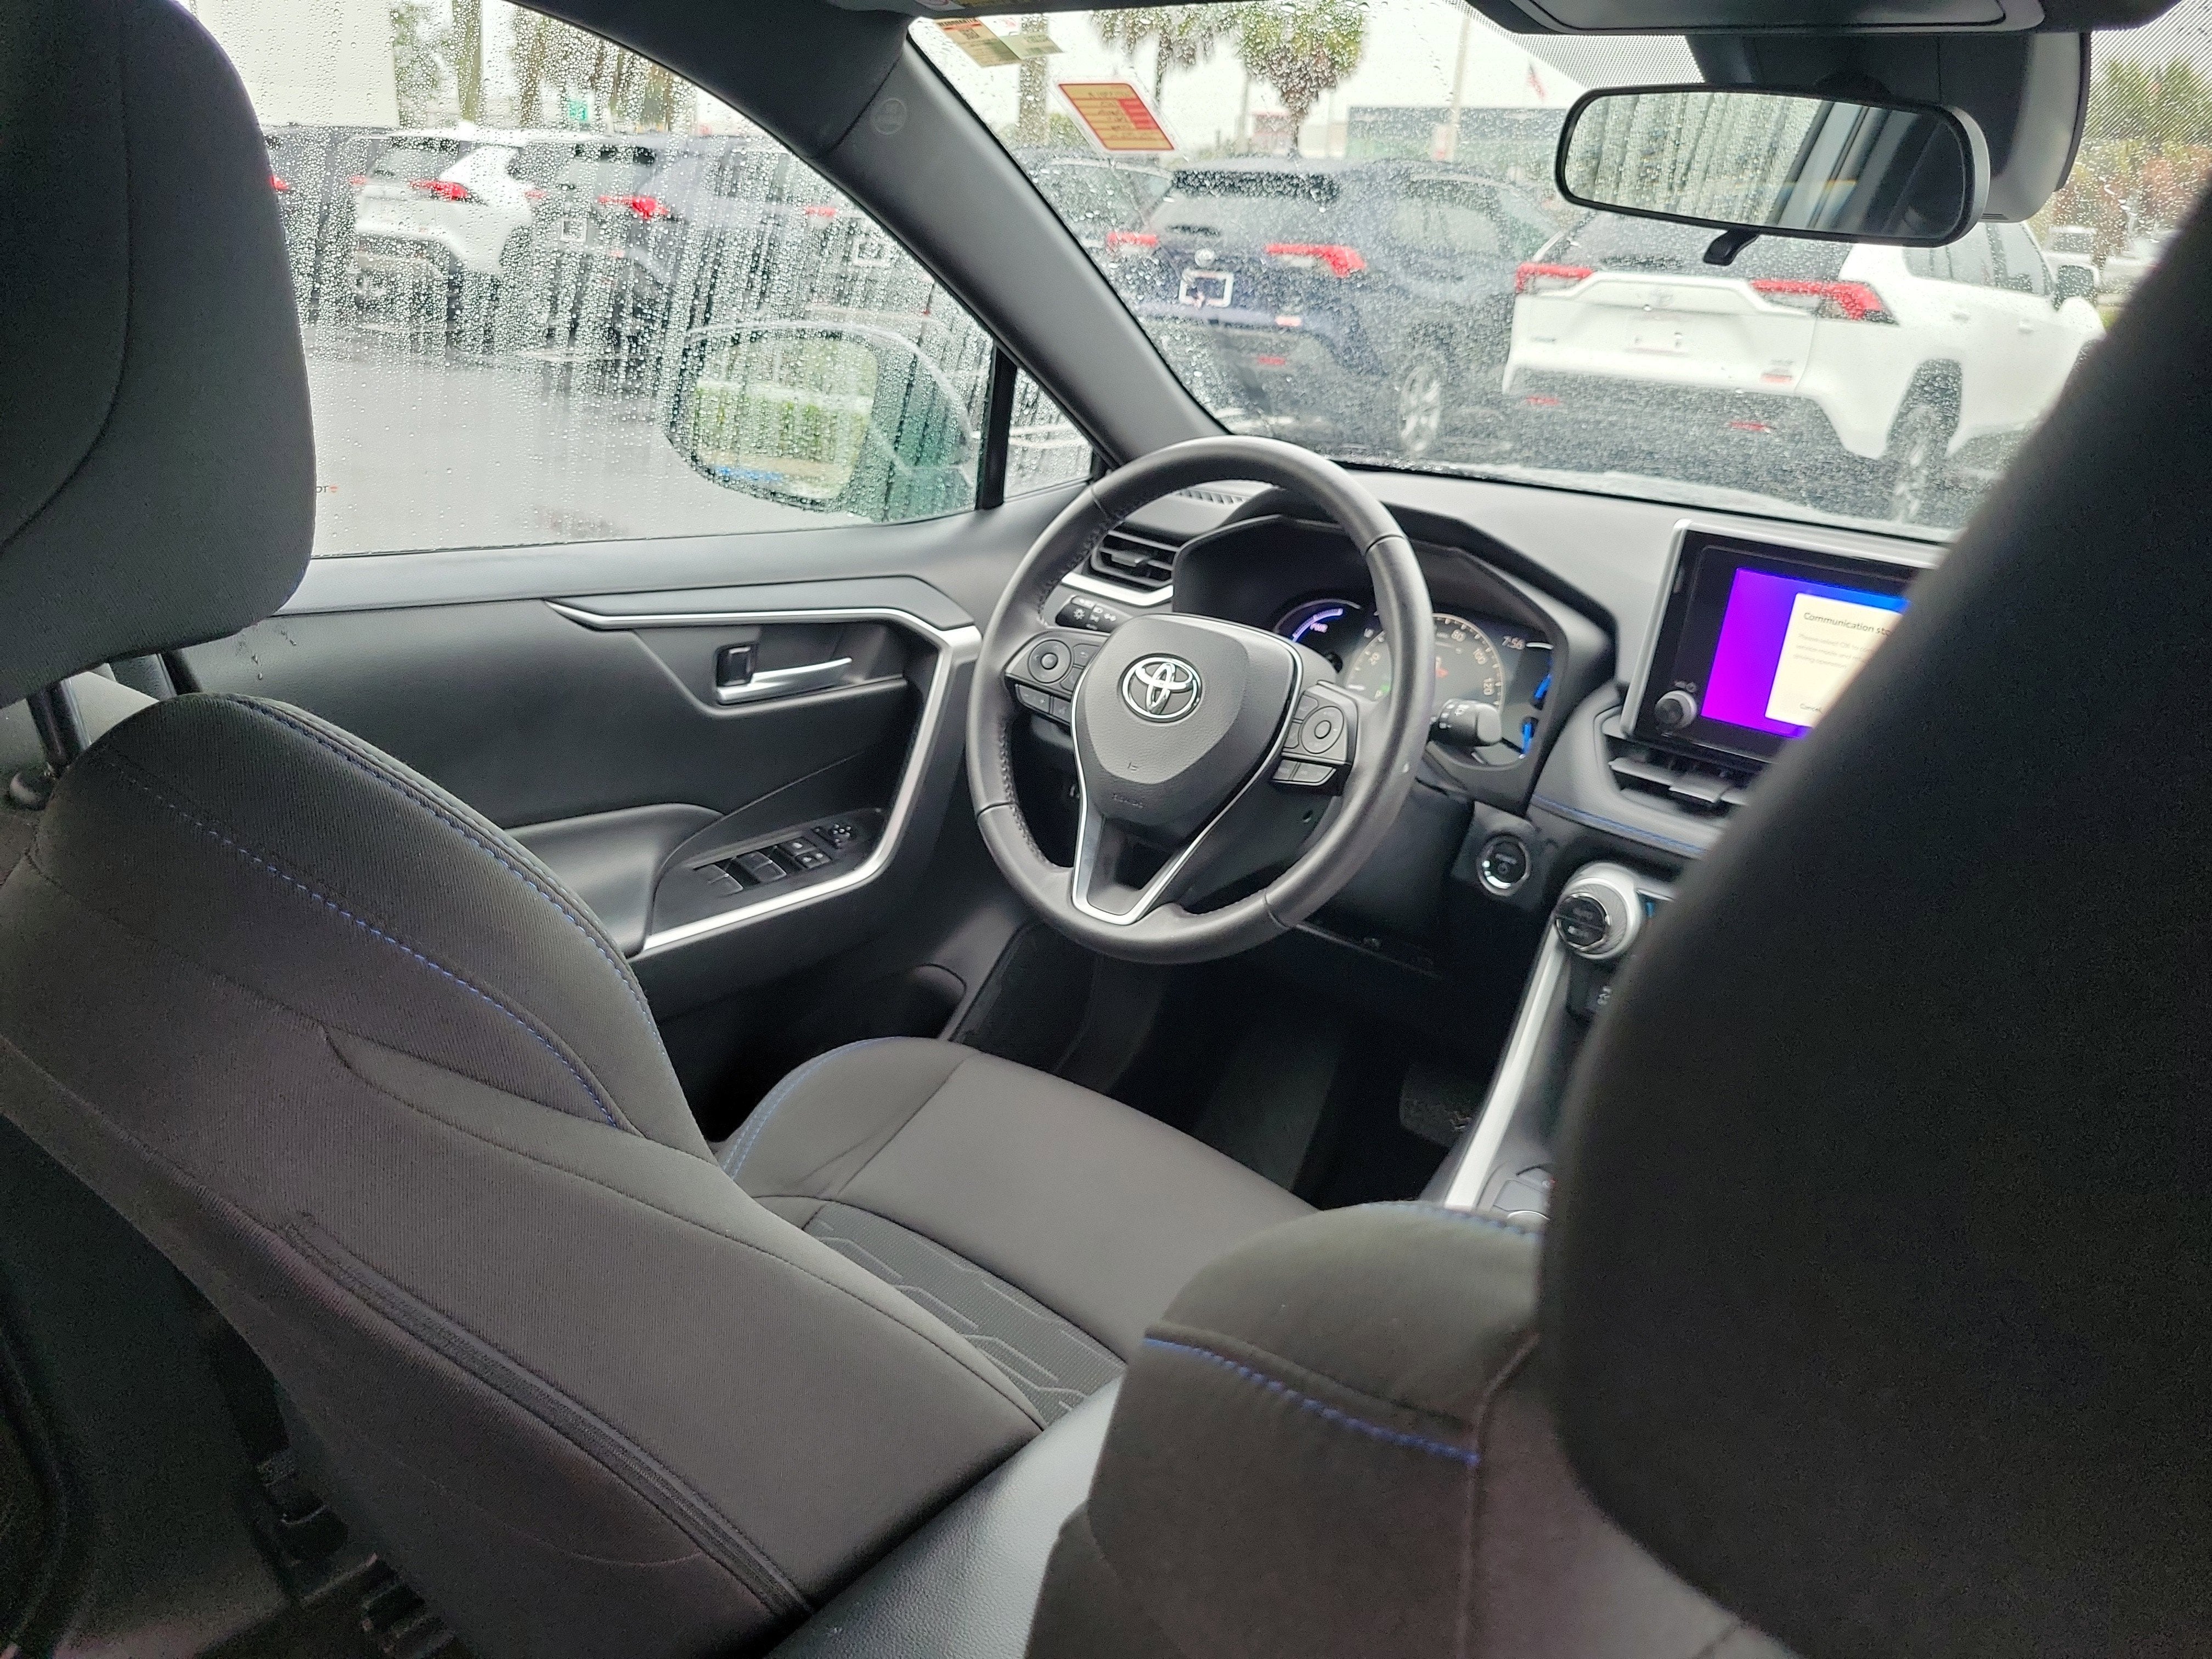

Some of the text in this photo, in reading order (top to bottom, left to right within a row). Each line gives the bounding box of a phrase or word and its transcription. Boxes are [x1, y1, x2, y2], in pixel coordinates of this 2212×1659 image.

[1804, 612, 1891, 636] Communication sto
[1451, 629, 1465, 642] 80
[1473, 648, 1487, 665] 100
[1483, 678, 1495, 695] 120
